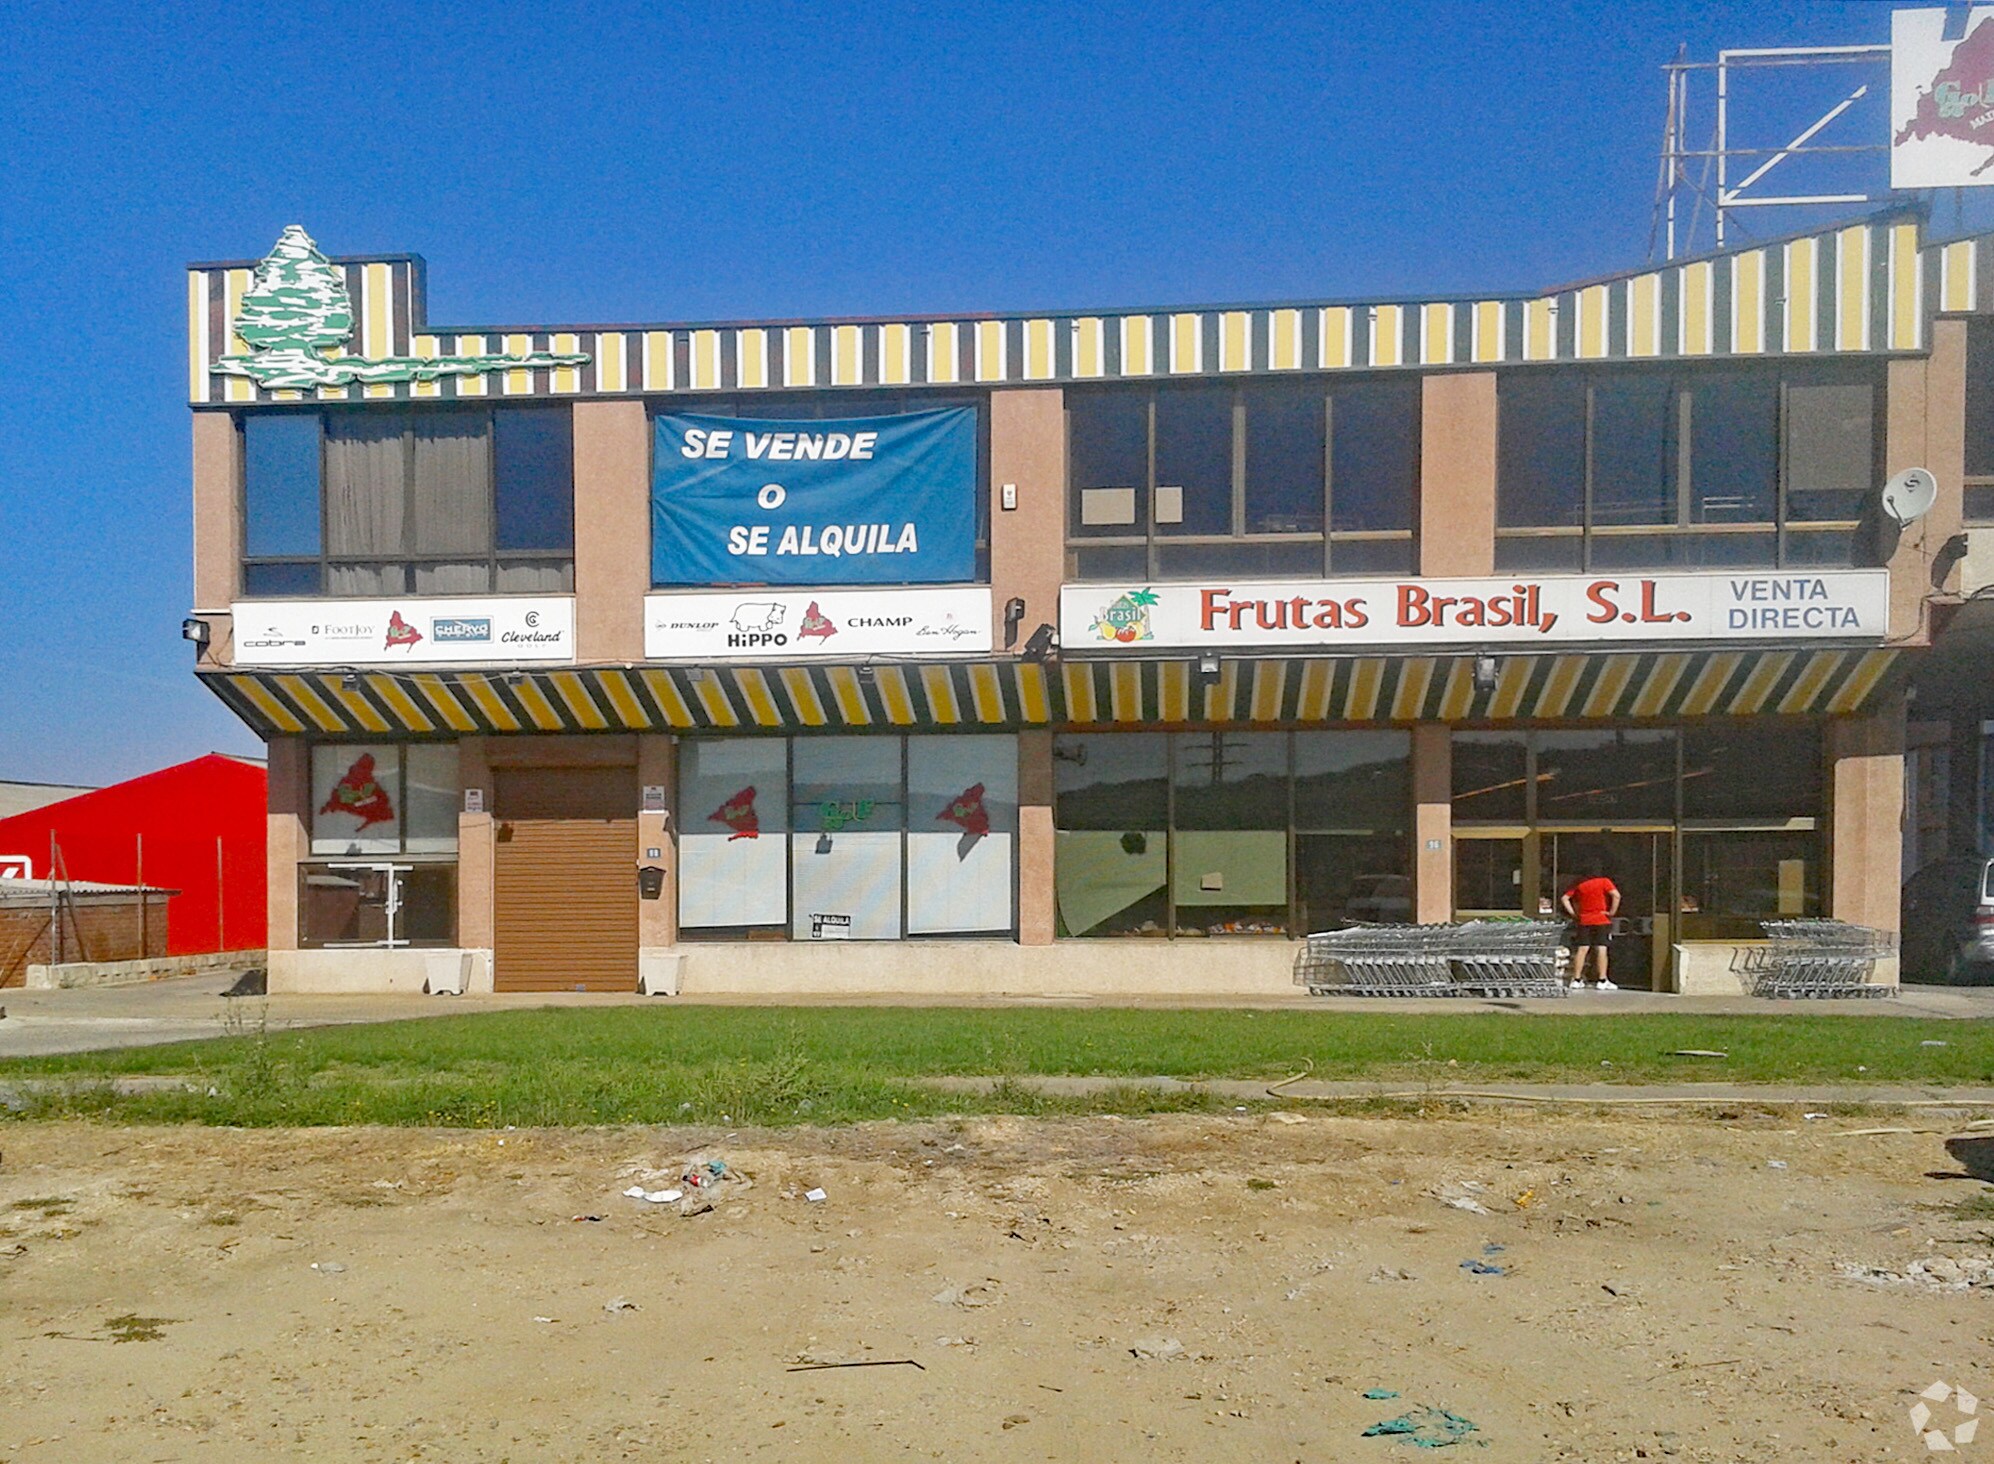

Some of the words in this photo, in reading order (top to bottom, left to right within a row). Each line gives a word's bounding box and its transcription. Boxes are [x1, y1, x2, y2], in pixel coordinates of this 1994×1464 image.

[681, 429, 733, 459] SE
[745, 432, 878, 460] VENDE
[757, 484, 786, 510] O
[727, 525, 770, 556] SE
[776, 523, 918, 558] ALQUILA
[1730, 578, 1829, 602] VENTA
[1200, 588, 1370, 631] Frutas
[1396, 584, 1558, 635] Brasil,
[1586, 579, 1693, 625] S.L.
[1728, 606, 1861, 632] DIRECTA
[847, 616, 913, 627] CHAMP
[243, 639, 306, 648] cobra
[501, 630, 562, 643] Cleveland
